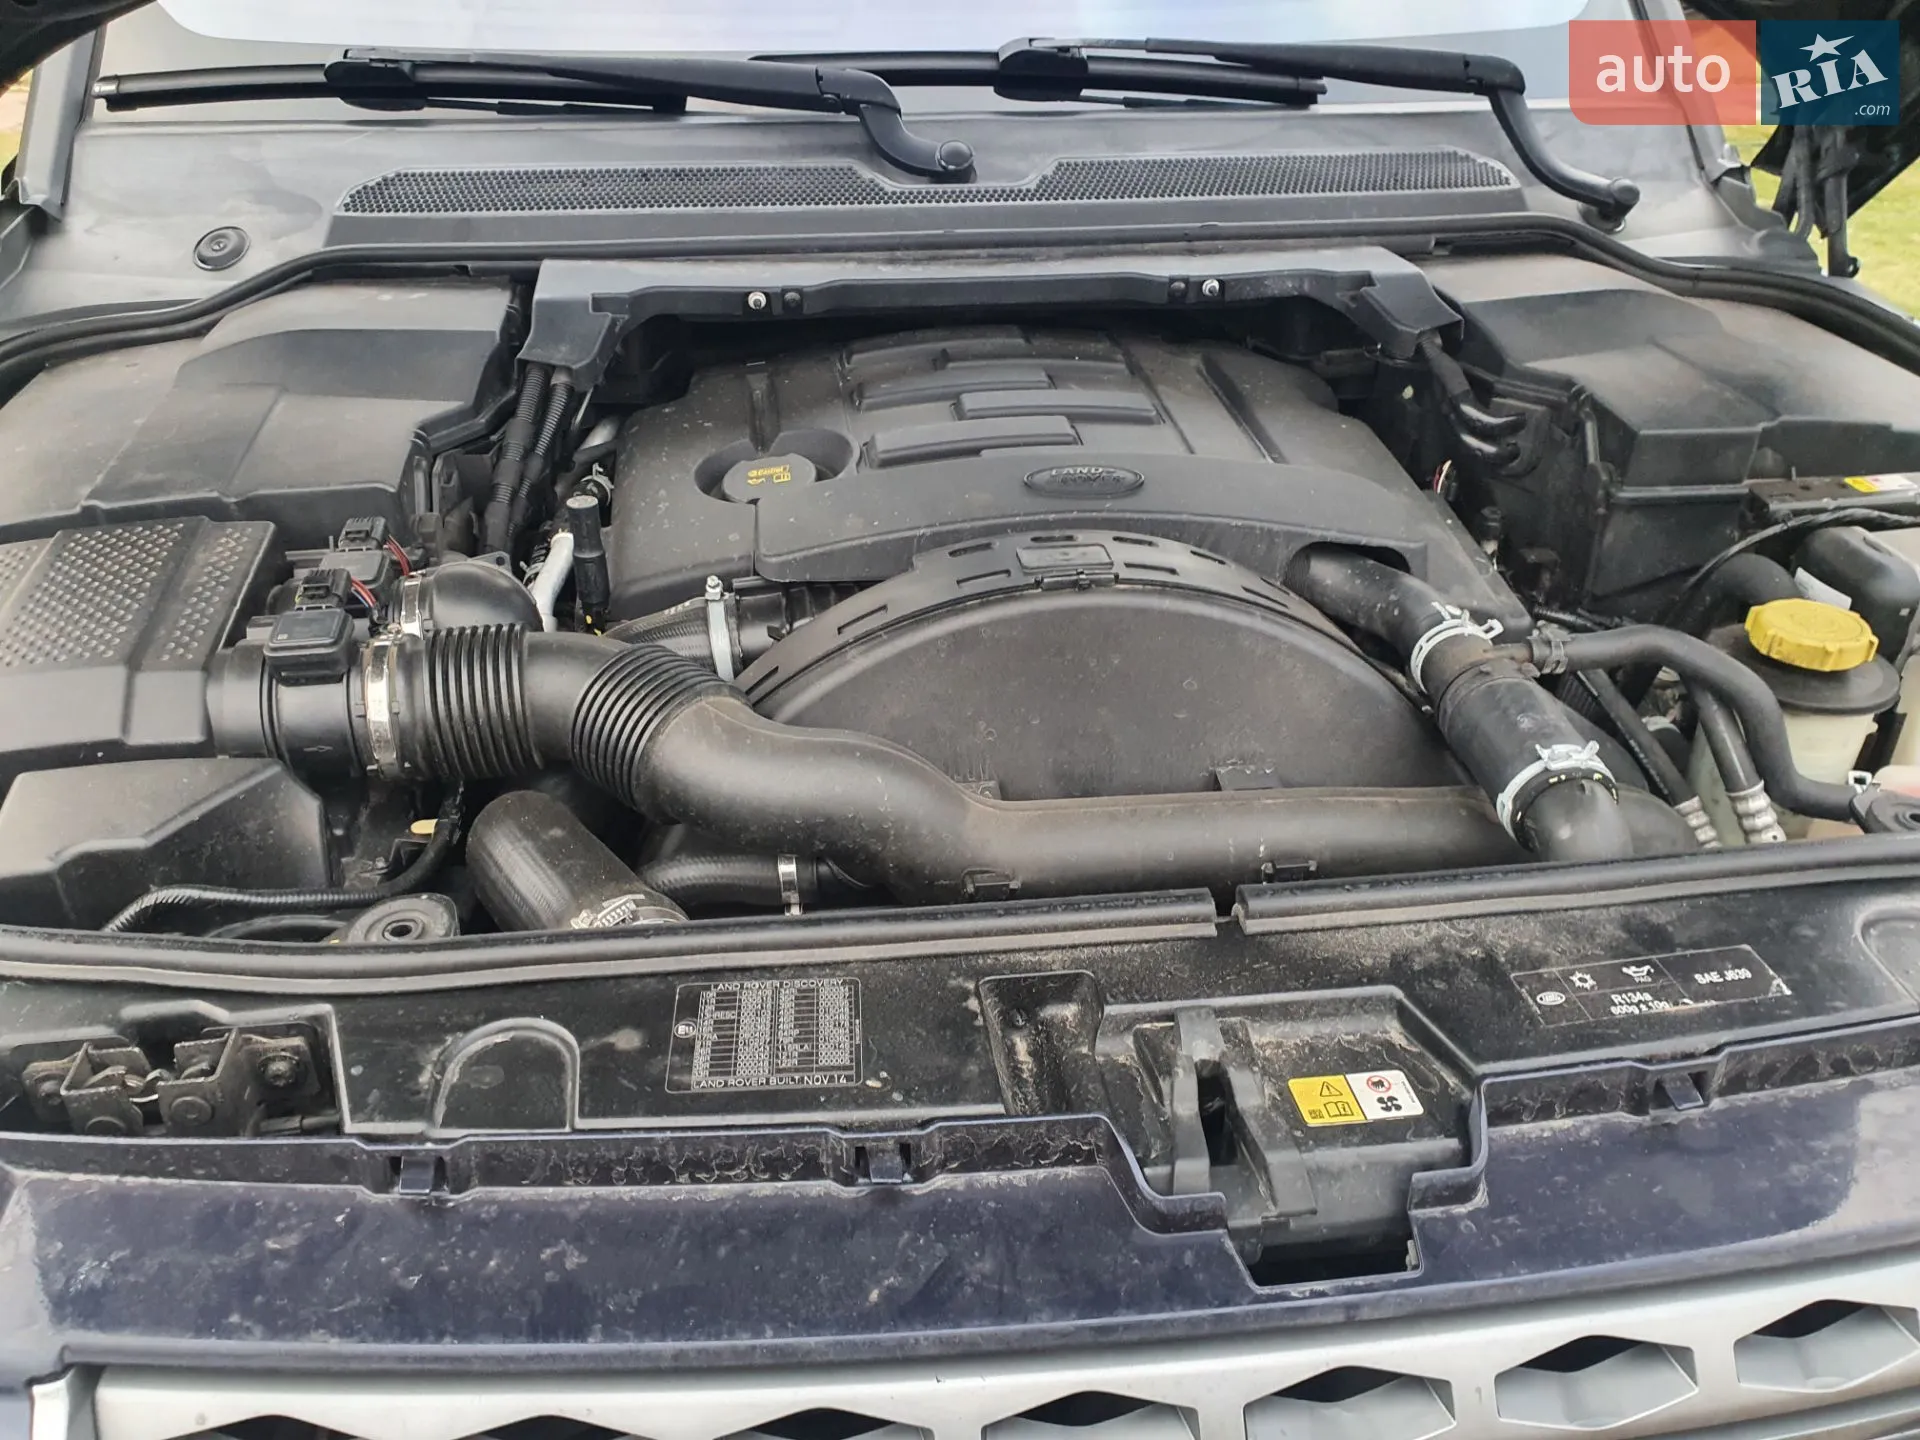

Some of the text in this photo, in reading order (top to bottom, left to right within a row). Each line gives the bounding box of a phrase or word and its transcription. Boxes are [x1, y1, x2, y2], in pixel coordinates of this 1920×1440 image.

[1051, 466, 1103, 475] LAND
[1694, 971, 1724, 984] SAE
[711, 979, 843, 991] LAND ROVER DISCOVERY
[1611, 991, 1653, 1005] R134a
[693, 1074, 847, 1088] LAND ROVER BUILT NOV 14
